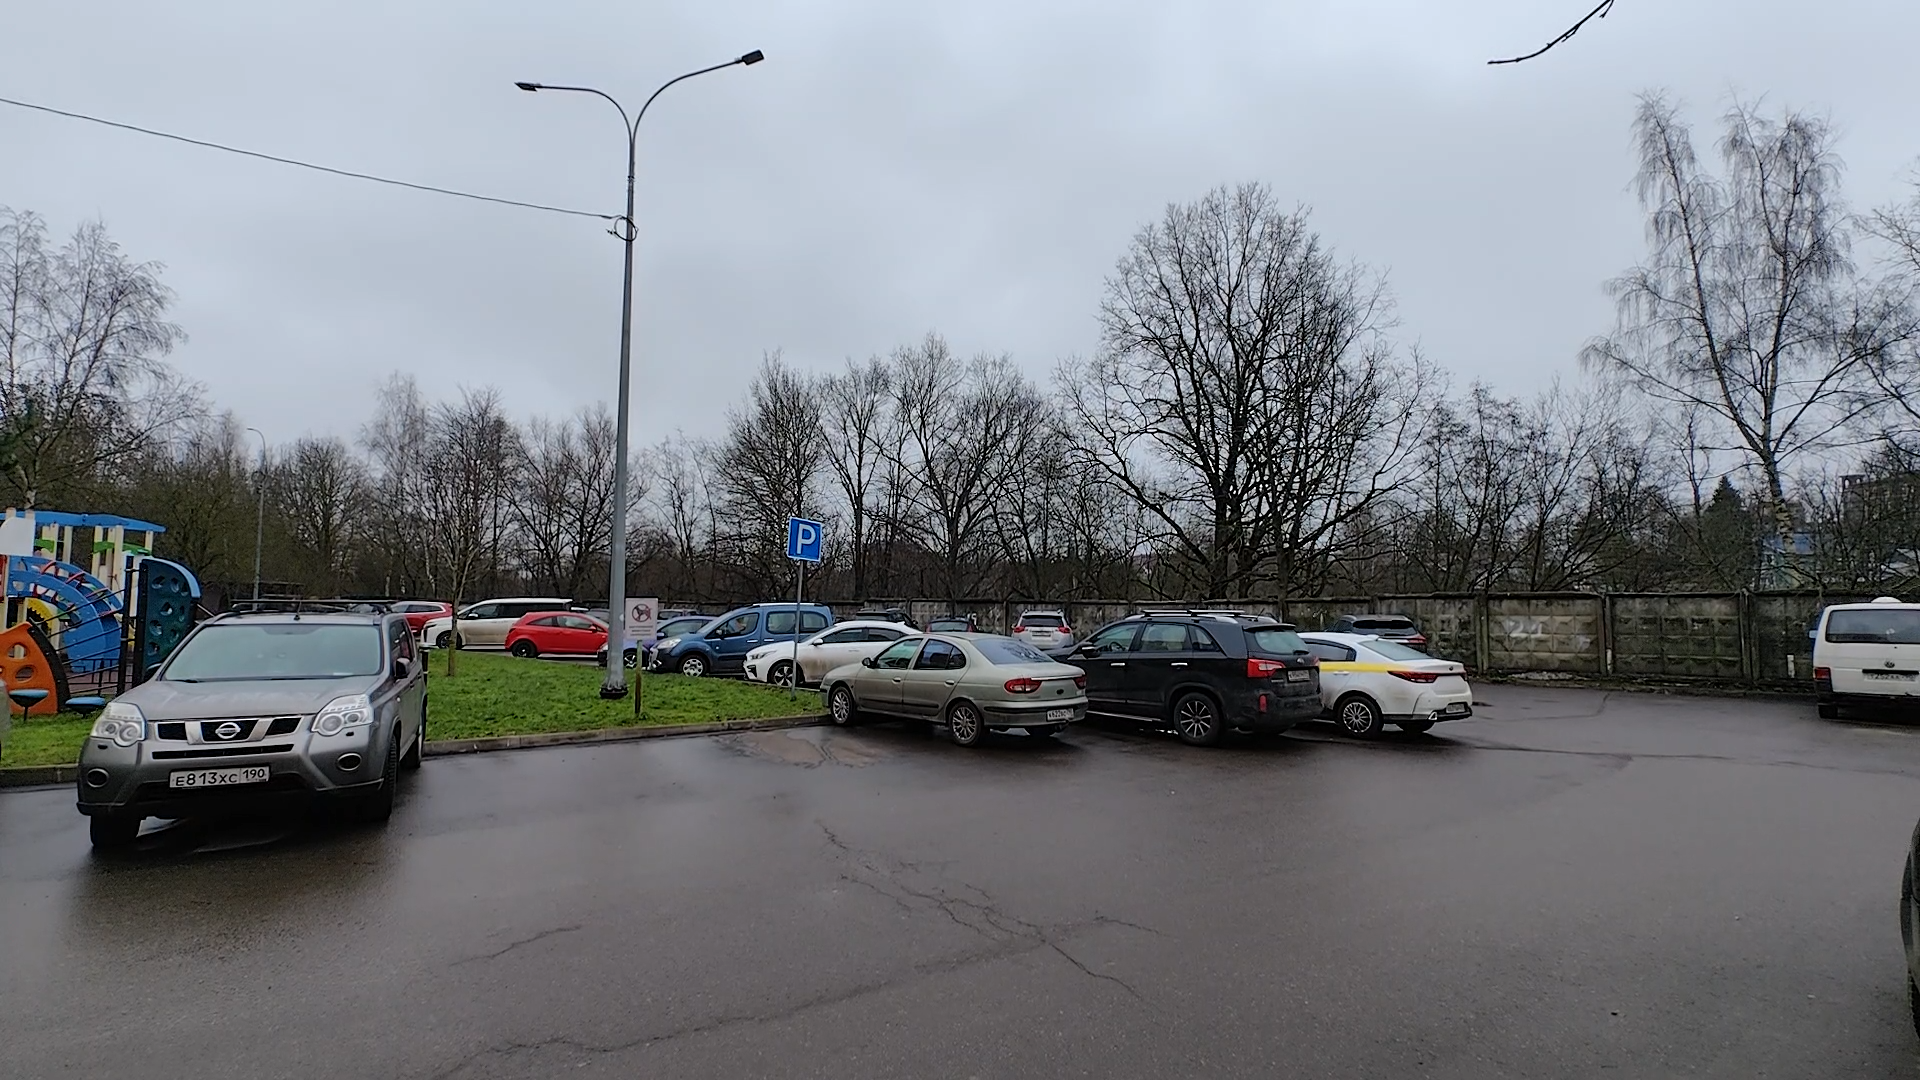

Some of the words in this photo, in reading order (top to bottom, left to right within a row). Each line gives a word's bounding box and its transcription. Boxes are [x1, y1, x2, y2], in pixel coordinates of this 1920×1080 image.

[797, 523, 816, 555] P
[175, 772, 238, 786] Е813ХС
[242, 768, 265, 779] 190
